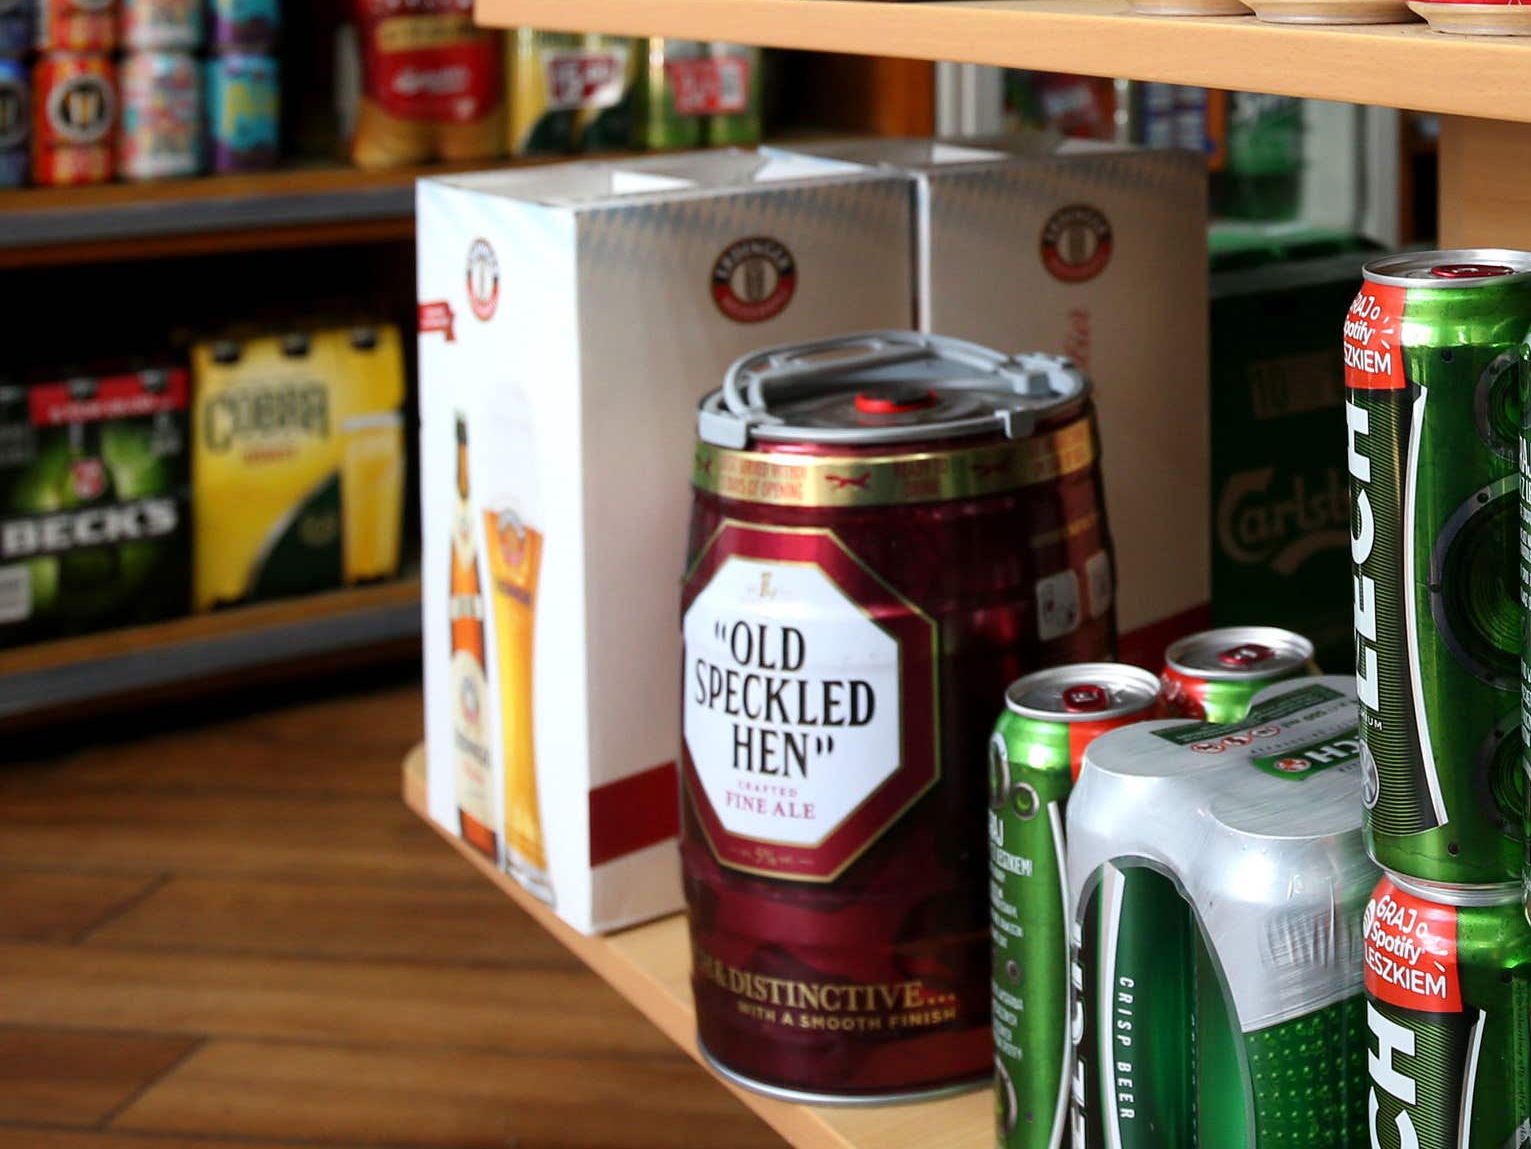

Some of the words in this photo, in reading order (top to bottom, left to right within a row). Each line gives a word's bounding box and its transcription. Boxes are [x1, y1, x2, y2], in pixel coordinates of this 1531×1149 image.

[694, 657, 876, 729] SPECKLED
[724, 790, 768, 815] FINE
[771, 796, 817, 821] ALE
[737, 779, 800, 799] CRAFTED
[1375, 894, 1419, 933] GRAJ
[1370, 921, 1420, 965] Spotify
[737, 1001, 777, 1023] WITH
[781, 1011, 795, 1027] A
[799, 1013, 883, 1031] SMOOTH
[887, 1009, 957, 1029] FINISH
[1119, 975, 1135, 1048] CRISP
[1116, 1060, 1136, 1121] BEER
